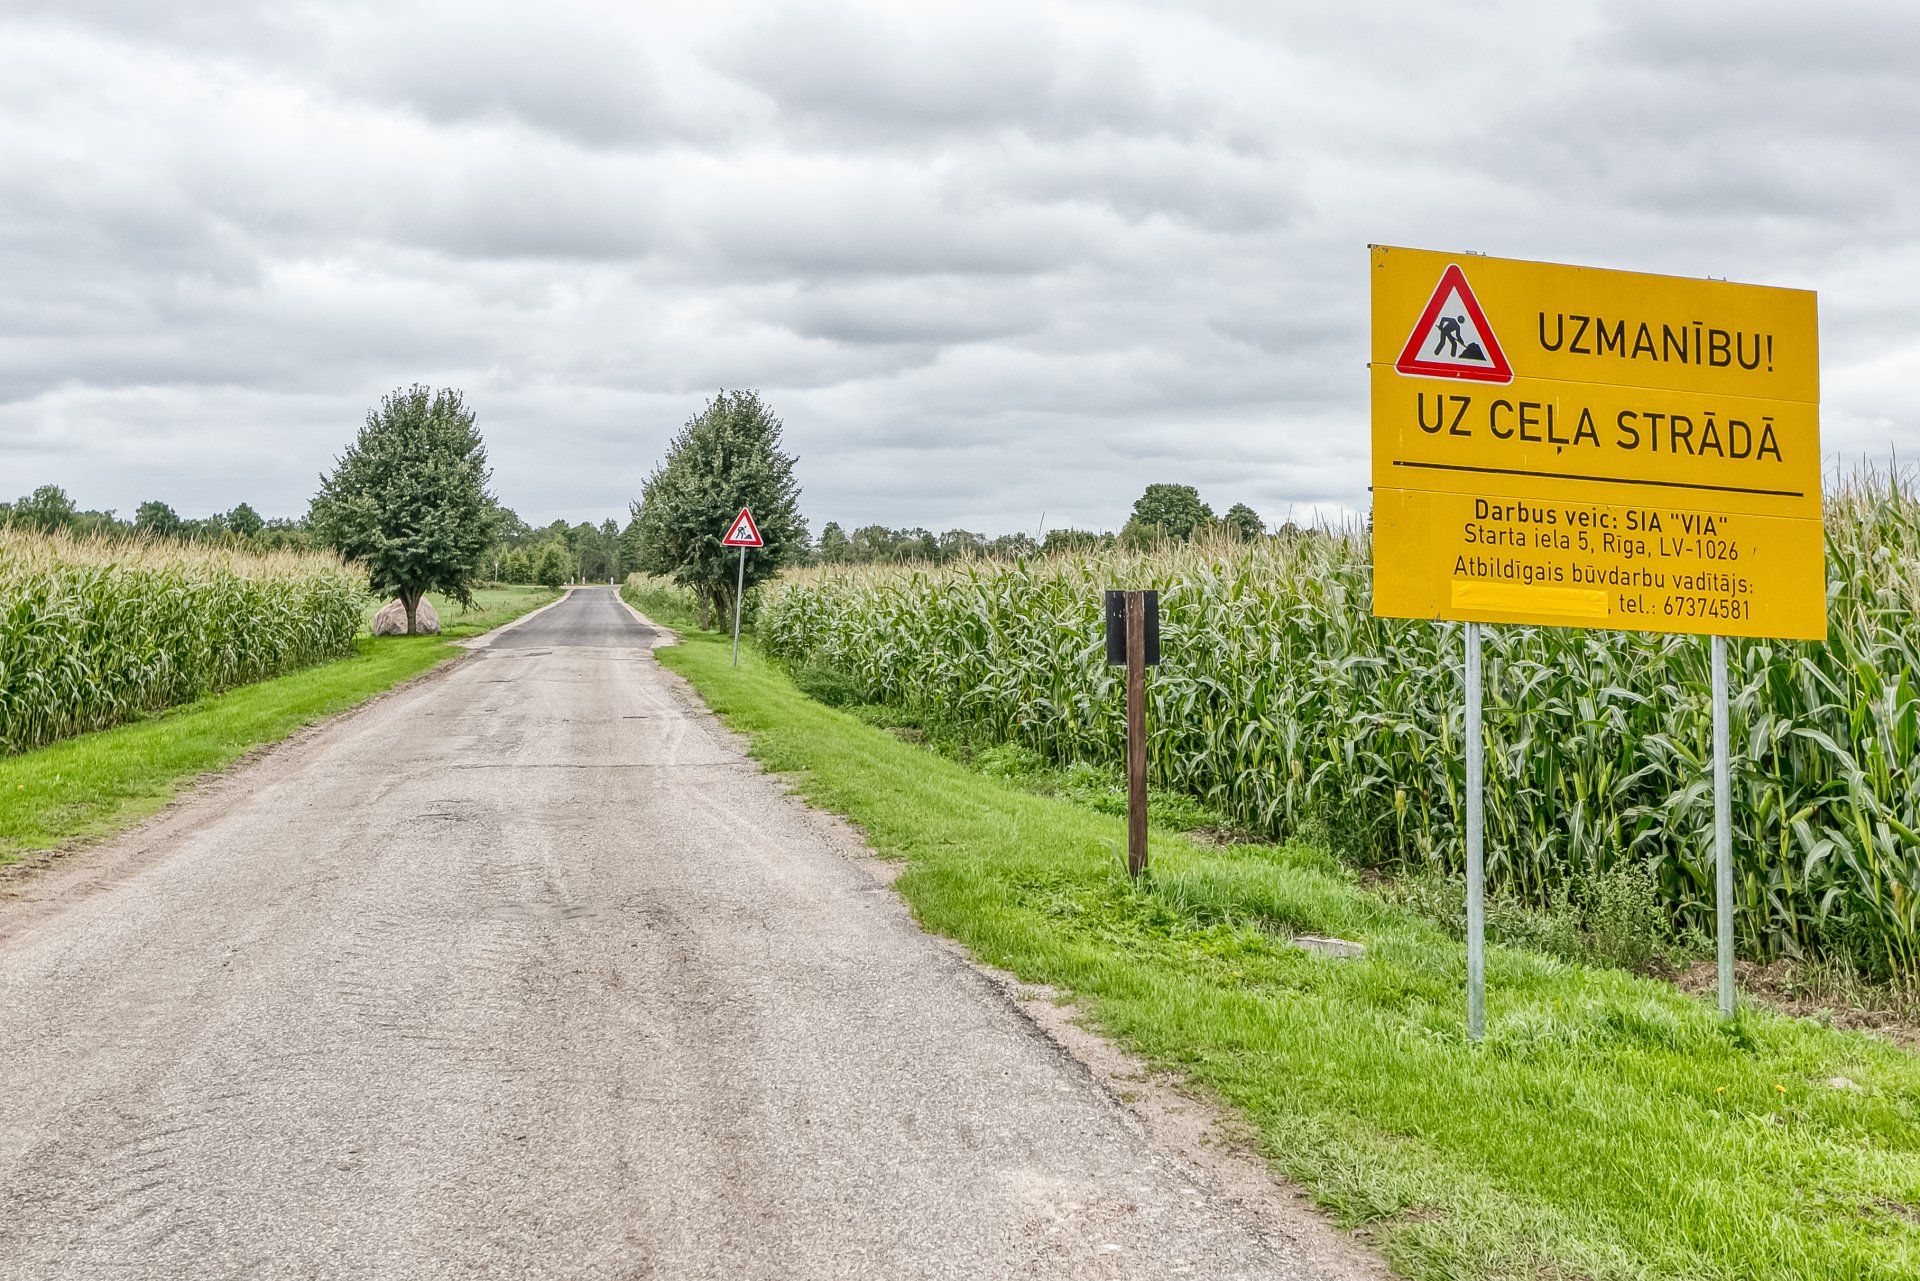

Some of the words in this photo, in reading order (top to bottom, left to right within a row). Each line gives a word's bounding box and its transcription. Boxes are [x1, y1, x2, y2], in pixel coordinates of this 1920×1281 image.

[1538, 311, 1774, 373] UZMANĪBU!
[1417, 392, 1472, 437] UZ
[1489, 399, 1601, 456] CEĻA
[1615, 410, 1783, 463] STRĀDĀ
[1475, 498, 1557, 525] Darbus
[1564, 506, 1618, 530] veic:
[1625, 509, 1663, 533] SIA
[1670, 512, 1728, 537] "VIA"
[1464, 522, 1526, 547] Starta
[1535, 528, 1570, 550] iela
[1578, 530, 1594, 554] 5,
[1603, 532, 1652, 560] Rīga,
[1660, 536, 1739, 561] LV-1026
[1453, 554, 1564, 586] Atbildīgais
[1572, 562, 1665, 589] būvdarbu
[1672, 570, 1754, 599] vadītājs:
[1618, 593, 1657, 616] tel.:
[1663, 595, 1749, 621] 67374581
